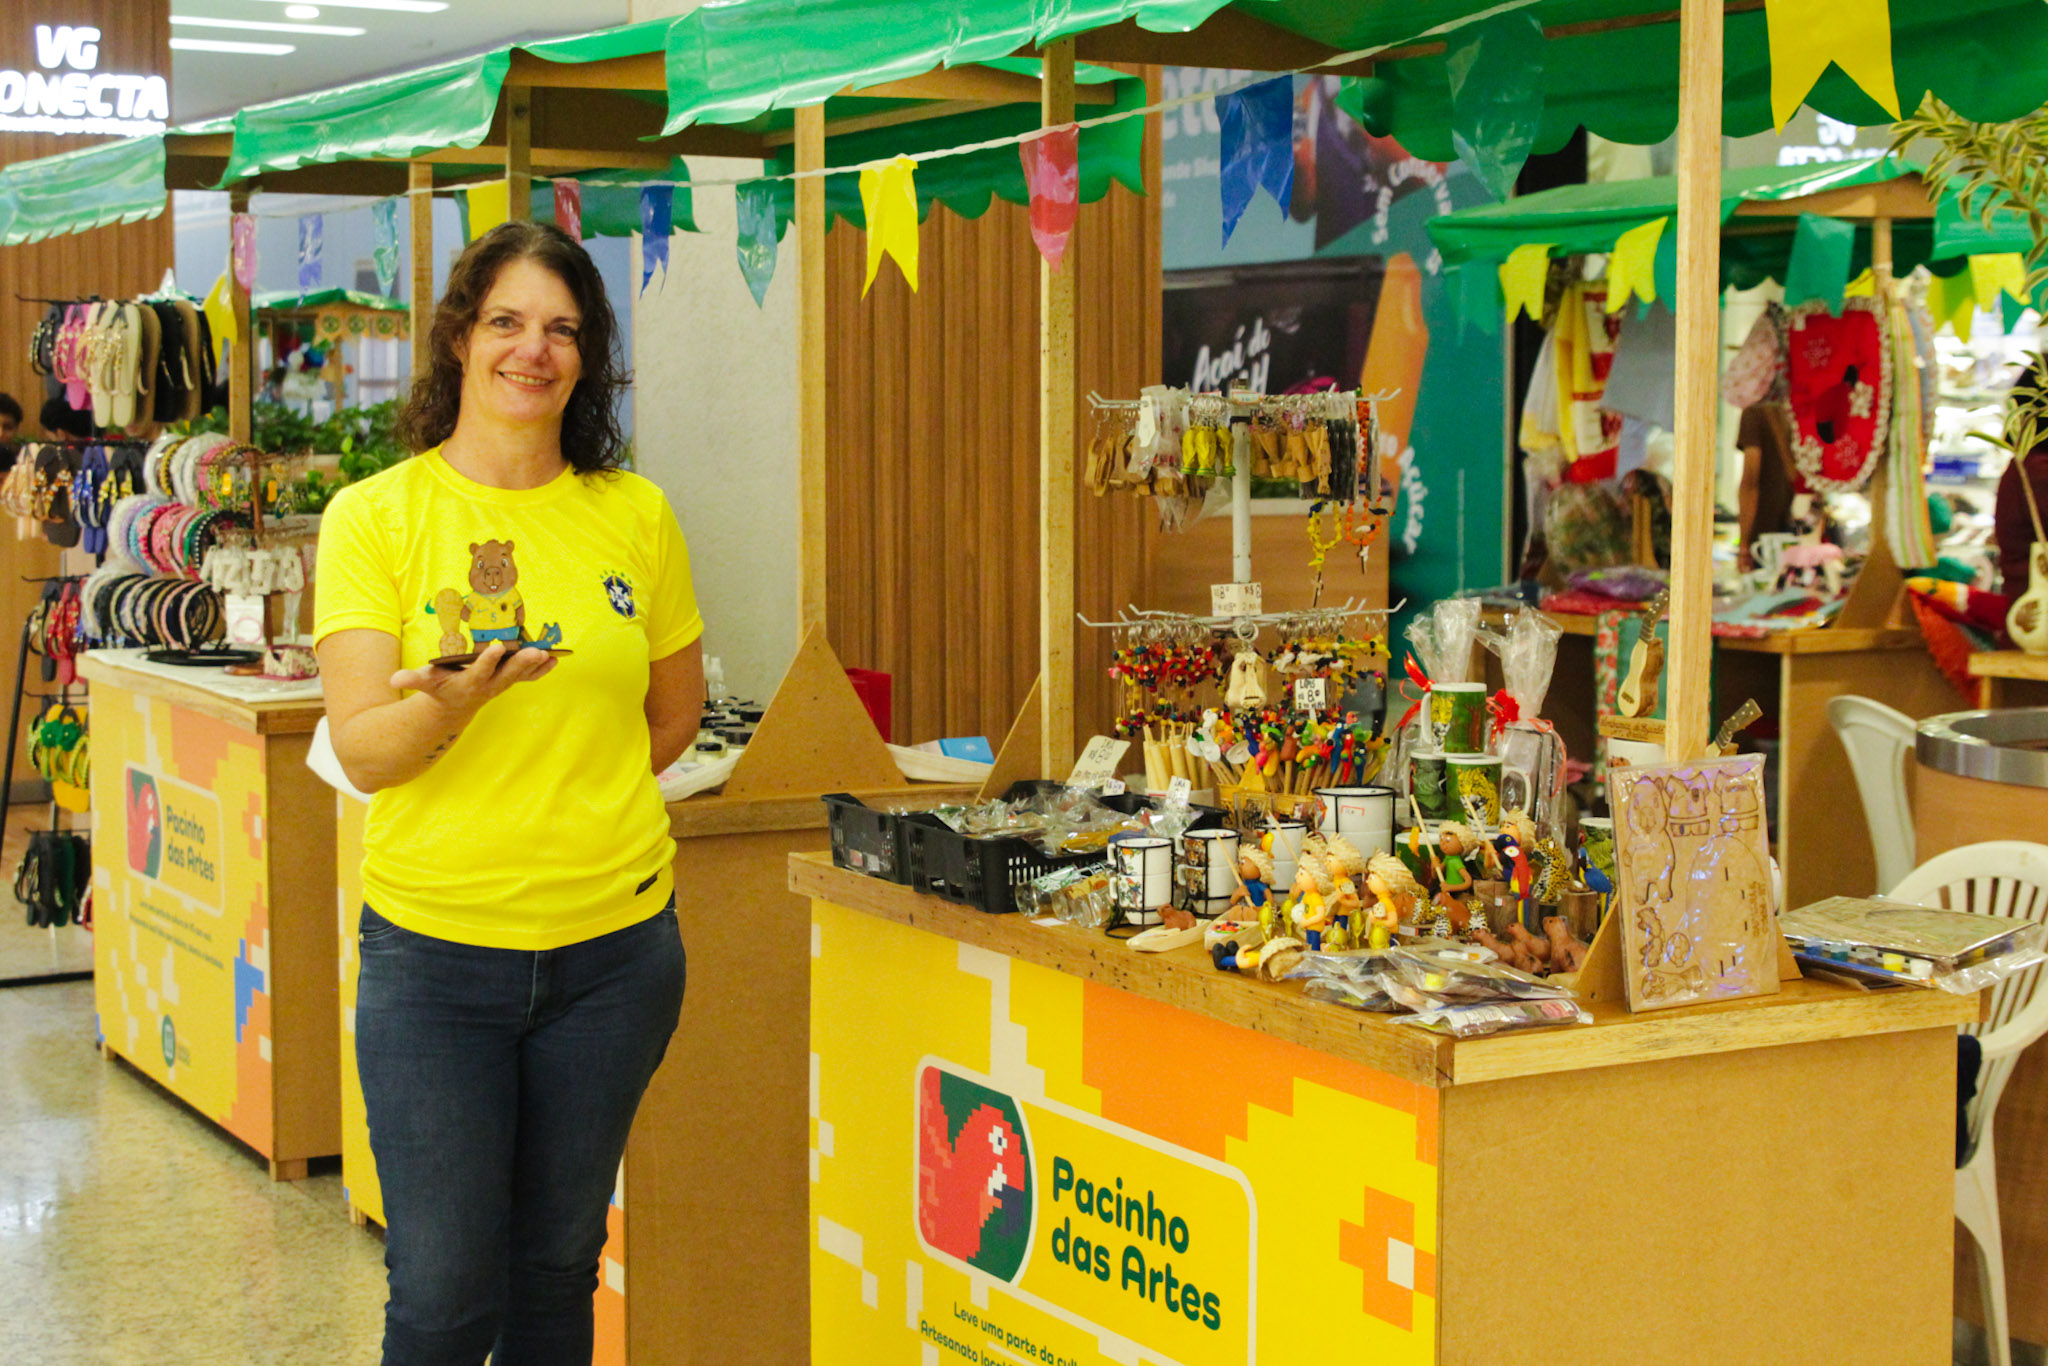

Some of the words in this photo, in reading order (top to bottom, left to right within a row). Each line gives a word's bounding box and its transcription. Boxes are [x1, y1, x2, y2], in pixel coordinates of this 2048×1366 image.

[36, 25, 101, 70] VG
[166, 804, 205, 844] Pacinho
[167, 837, 185, 868] das
[187, 845, 215, 882] Artes
[1053, 1156, 1189, 1254] Pacinho
[1052, 1216, 1111, 1282] das
[1121, 1245, 1221, 1331] Artes
[921, 1320, 978, 1362] Artesanato
[954, 1301, 978, 1327] Leve
[981, 1319, 1004, 1340] uma
[1006, 1331, 1037, 1357] parte
[1040, 1345, 1054, 1365] da
